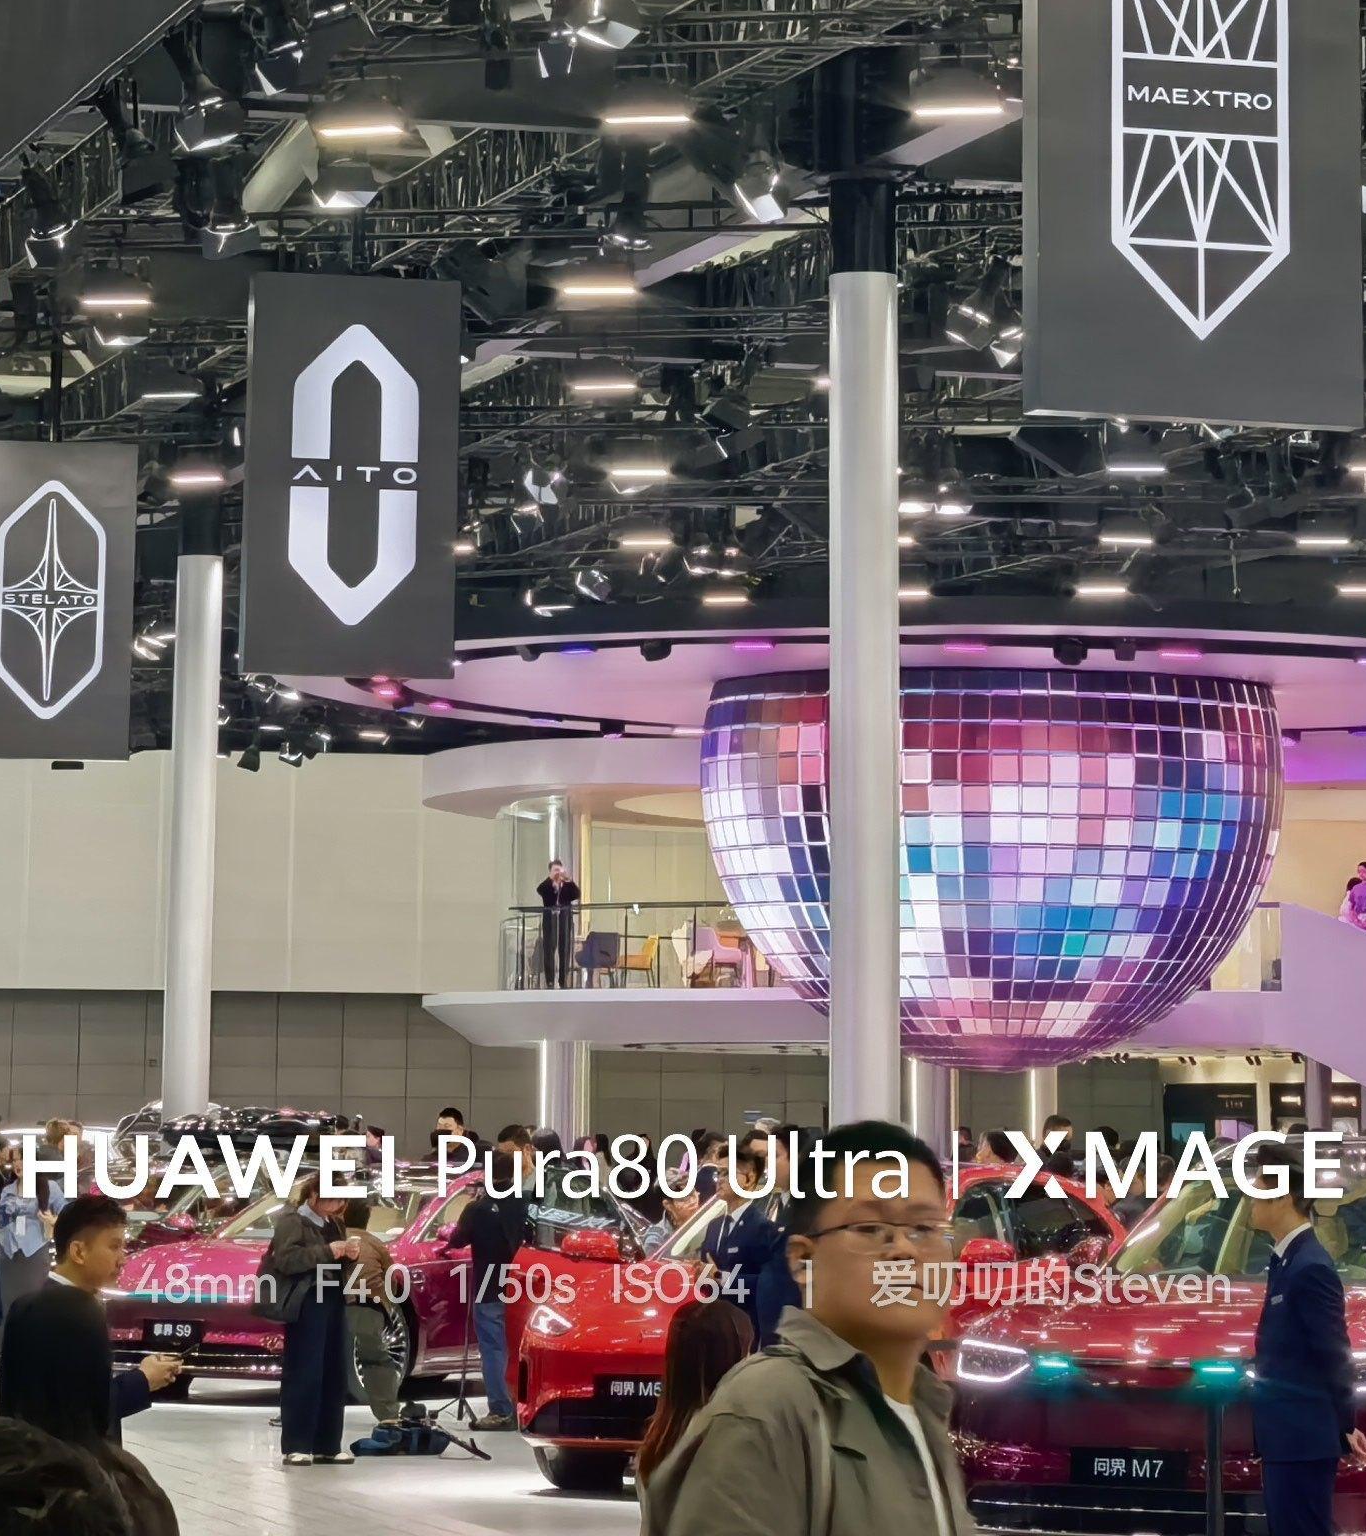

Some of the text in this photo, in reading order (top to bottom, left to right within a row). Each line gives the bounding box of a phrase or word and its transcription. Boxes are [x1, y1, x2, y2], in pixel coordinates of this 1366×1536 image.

[1127, 84, 1272, 110] MAEXTRO
[292, 464, 417, 485] AITO
[4, 593, 95, 606] STELATO
[176, 1325, 191, 1337] S9
[1094, 1458, 1163, 1478] 问界 M7
